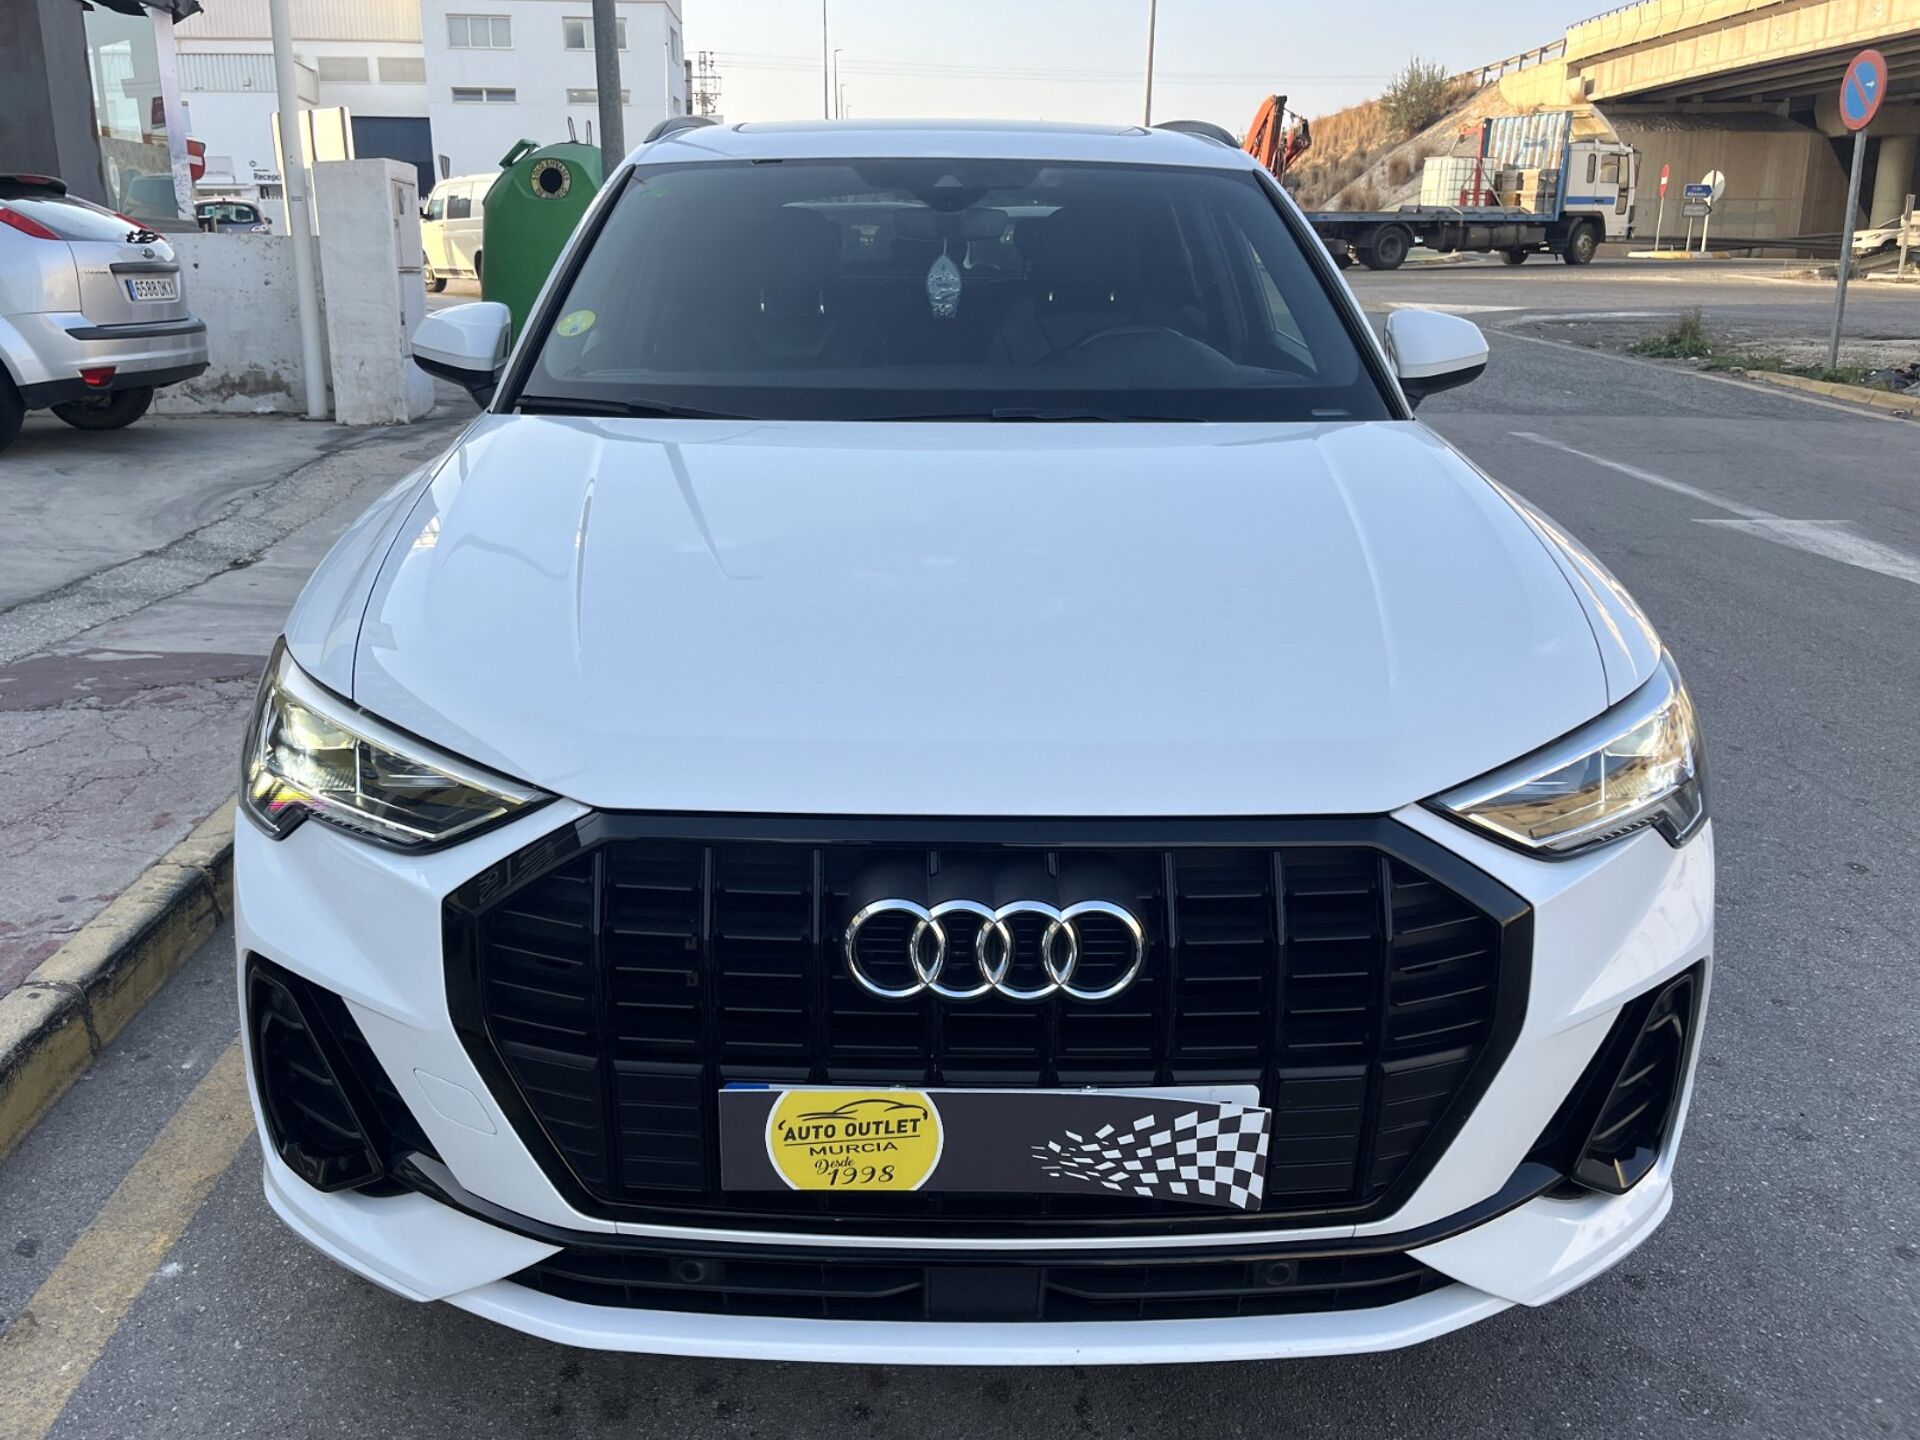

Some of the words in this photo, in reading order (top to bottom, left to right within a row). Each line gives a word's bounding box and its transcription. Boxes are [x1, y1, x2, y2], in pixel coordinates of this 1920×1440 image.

[783, 1124, 836, 1142] AUTO
[844, 1118, 921, 1138] OUTLET
[809, 1141, 898, 1157] MURCIA
[814, 1156, 854, 1175] Desde
[827, 1164, 895, 1186] 1998
